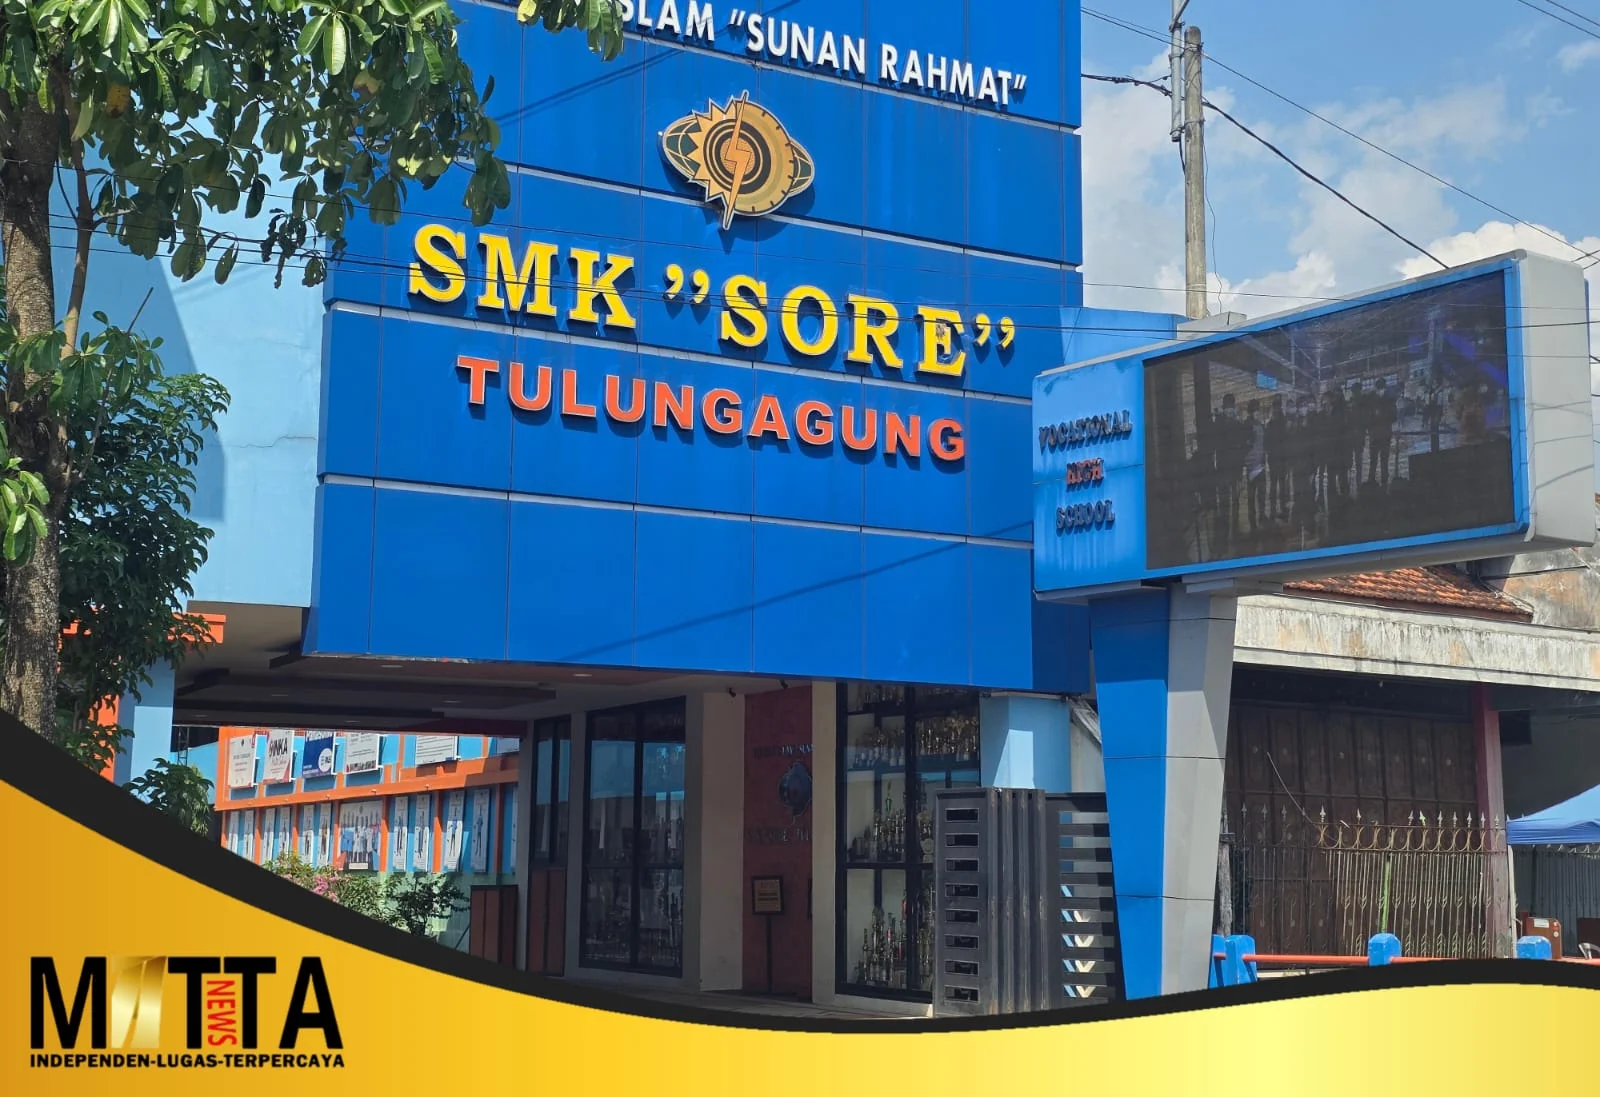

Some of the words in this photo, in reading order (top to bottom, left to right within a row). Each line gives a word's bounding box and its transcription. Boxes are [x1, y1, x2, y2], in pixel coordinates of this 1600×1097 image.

[617, 0, 715, 41] SLAM
[729, 8, 866, 75] "SUNAN
[880, 43, 1028, 106] RAHMAT"
[407, 223, 637, 329] SMK
[456, 355, 966, 461] TULUNGAGUNG
[1056, 500, 1115, 531] SCHOOL
